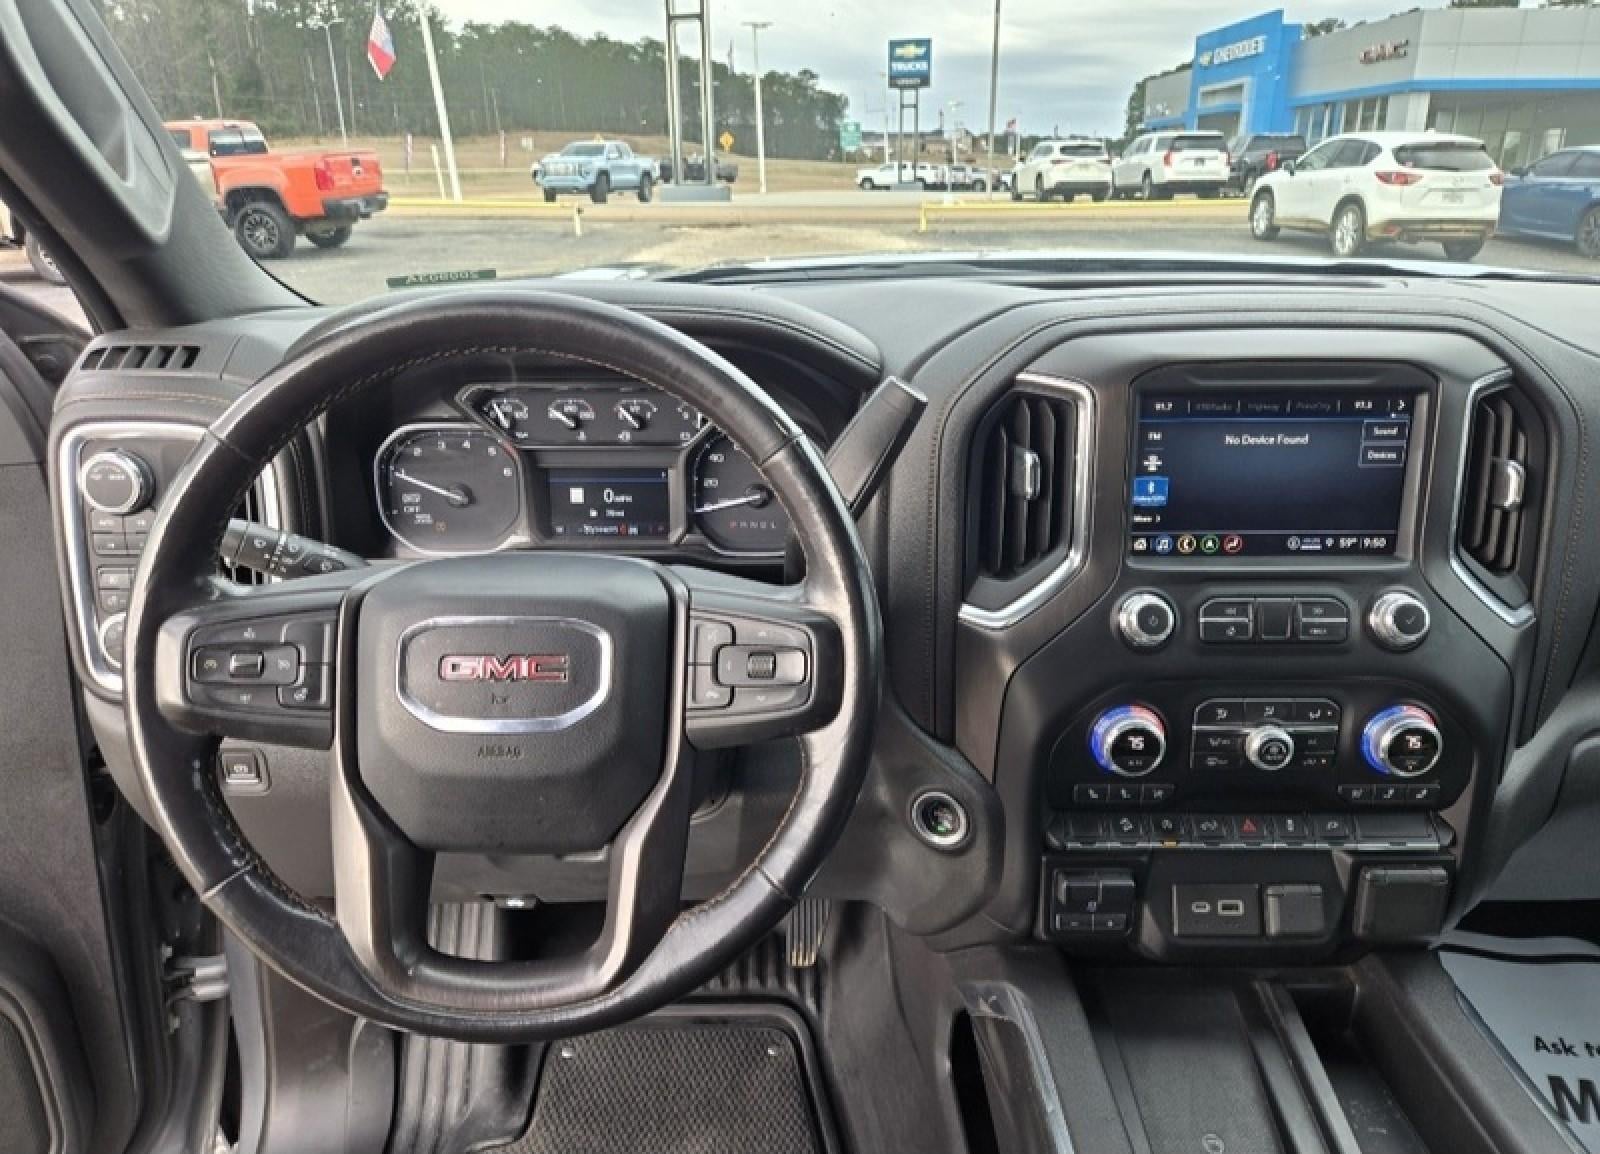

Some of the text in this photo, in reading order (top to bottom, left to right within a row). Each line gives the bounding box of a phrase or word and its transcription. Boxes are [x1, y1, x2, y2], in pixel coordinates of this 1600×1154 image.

[1225, 433, 1309, 445] No Device Found
[439, 655, 569, 682] GMC
[1535, 1035, 1578, 1057] Ask
